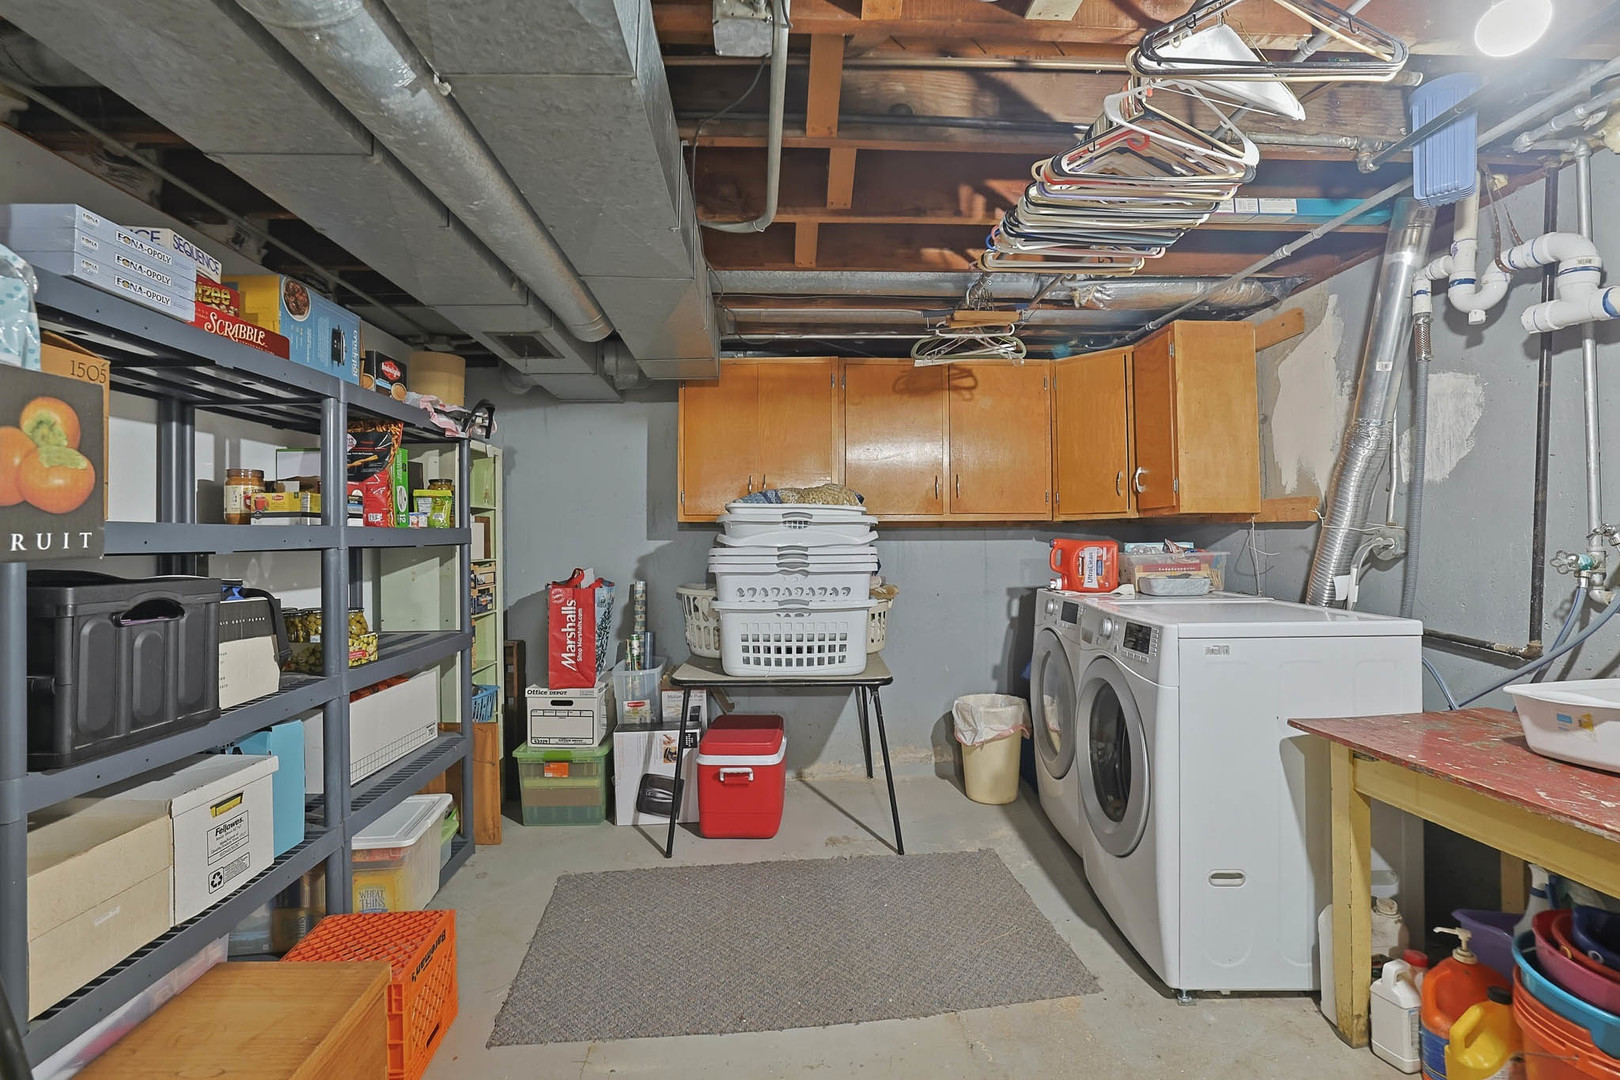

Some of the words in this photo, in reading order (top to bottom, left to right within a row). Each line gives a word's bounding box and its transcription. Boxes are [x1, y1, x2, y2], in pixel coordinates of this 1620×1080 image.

[172, 234, 219, 276] SEQUENCE
[204, 311, 266, 346] SCRABBLE
[561, 599, 577, 671] Marshalls
[359, 889, 384, 900] WHEAT
